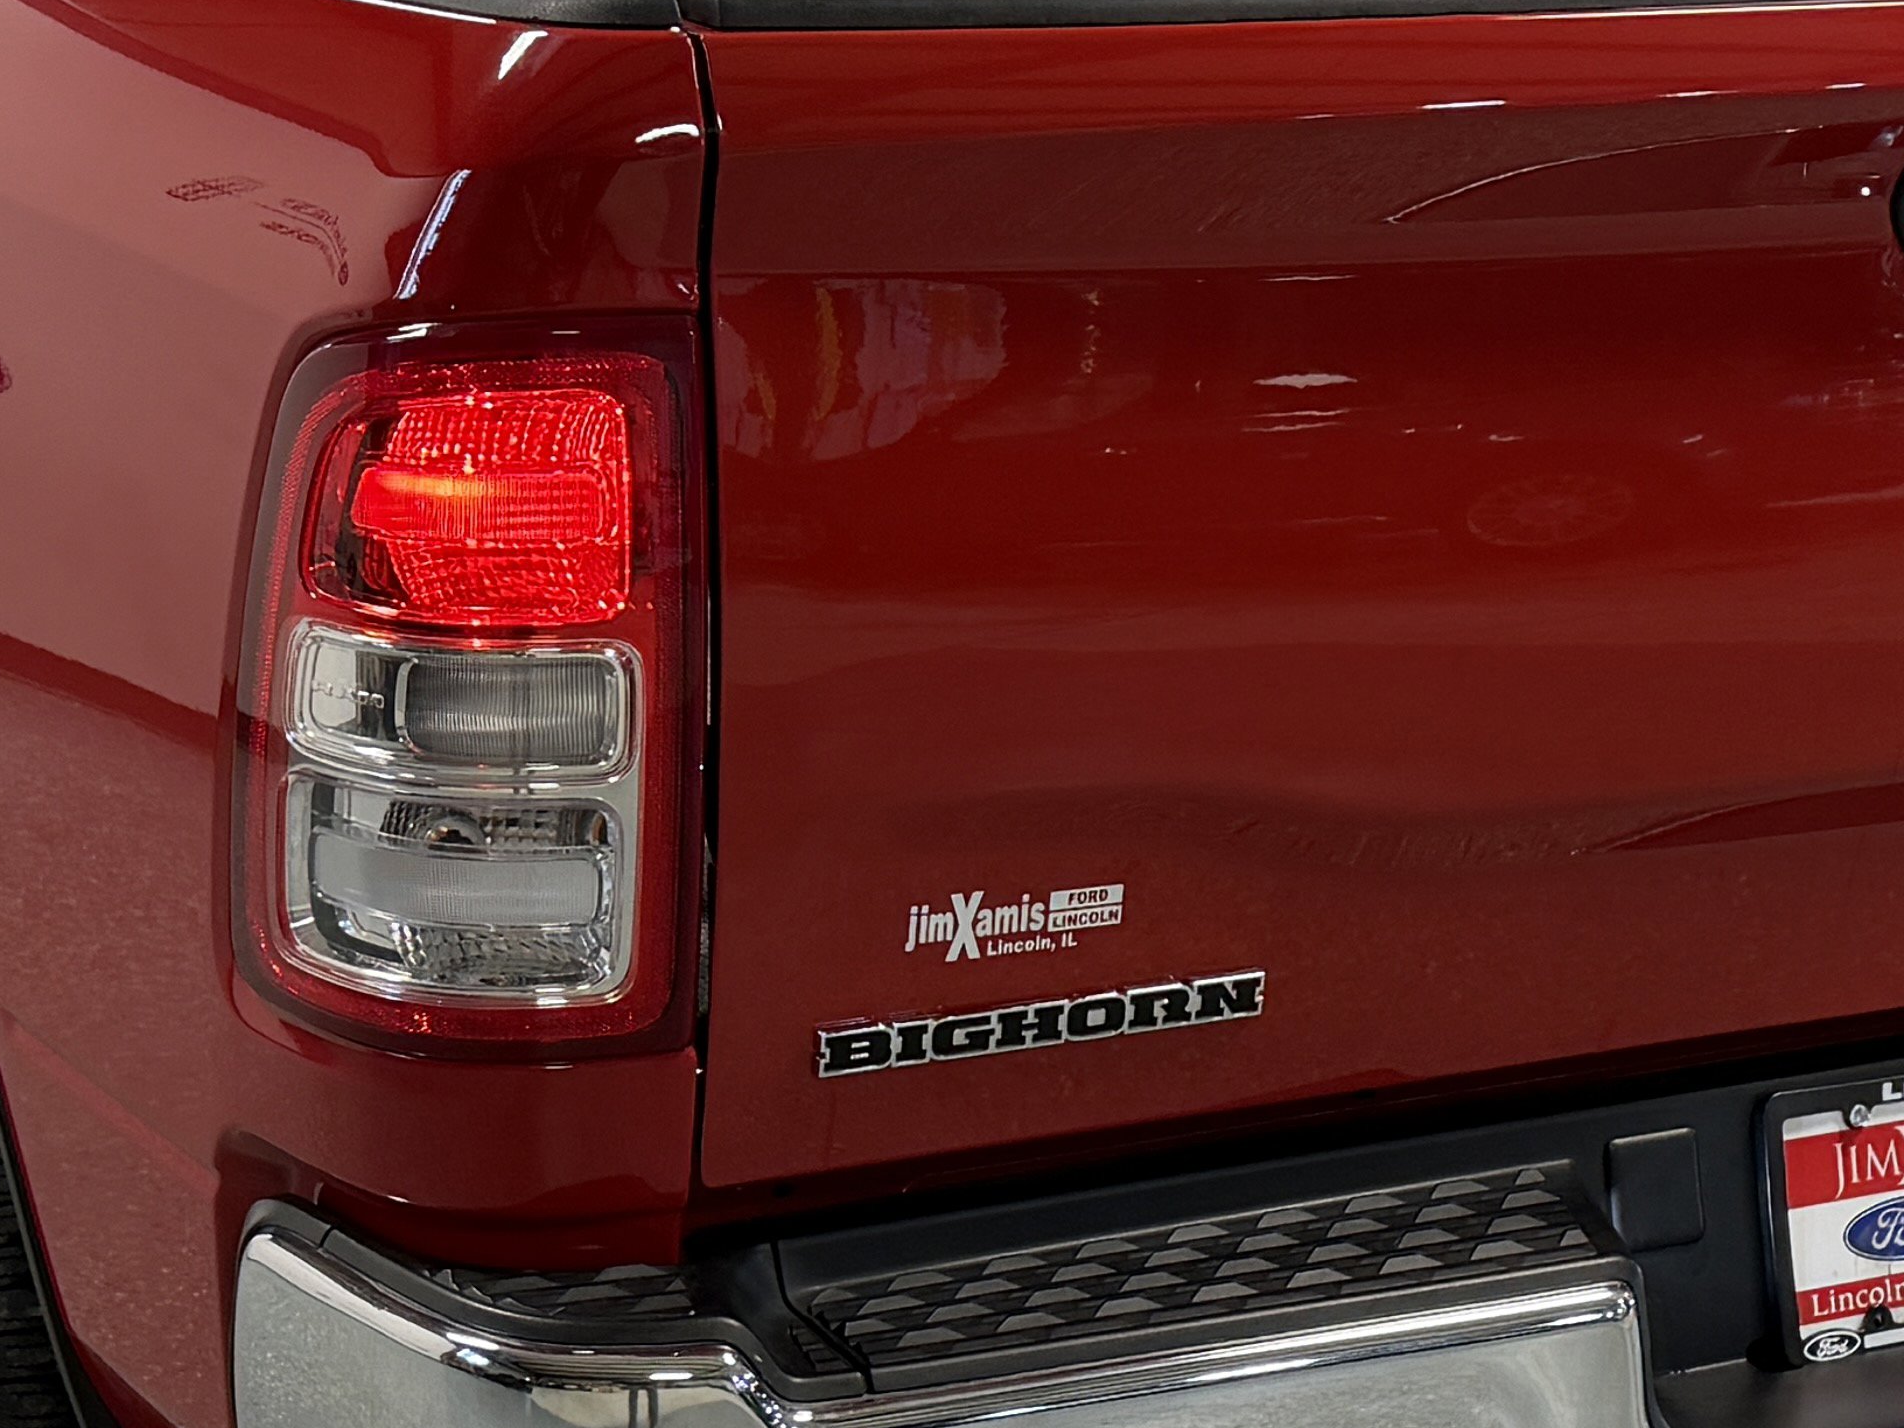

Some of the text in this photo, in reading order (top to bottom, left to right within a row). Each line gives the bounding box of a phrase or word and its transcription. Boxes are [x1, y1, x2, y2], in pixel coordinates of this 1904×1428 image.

[1067, 887, 1110, 907] FORD
[1051, 907, 1120, 929] LINCOLN
[986, 932, 1079, 957] Lincoln, IL
